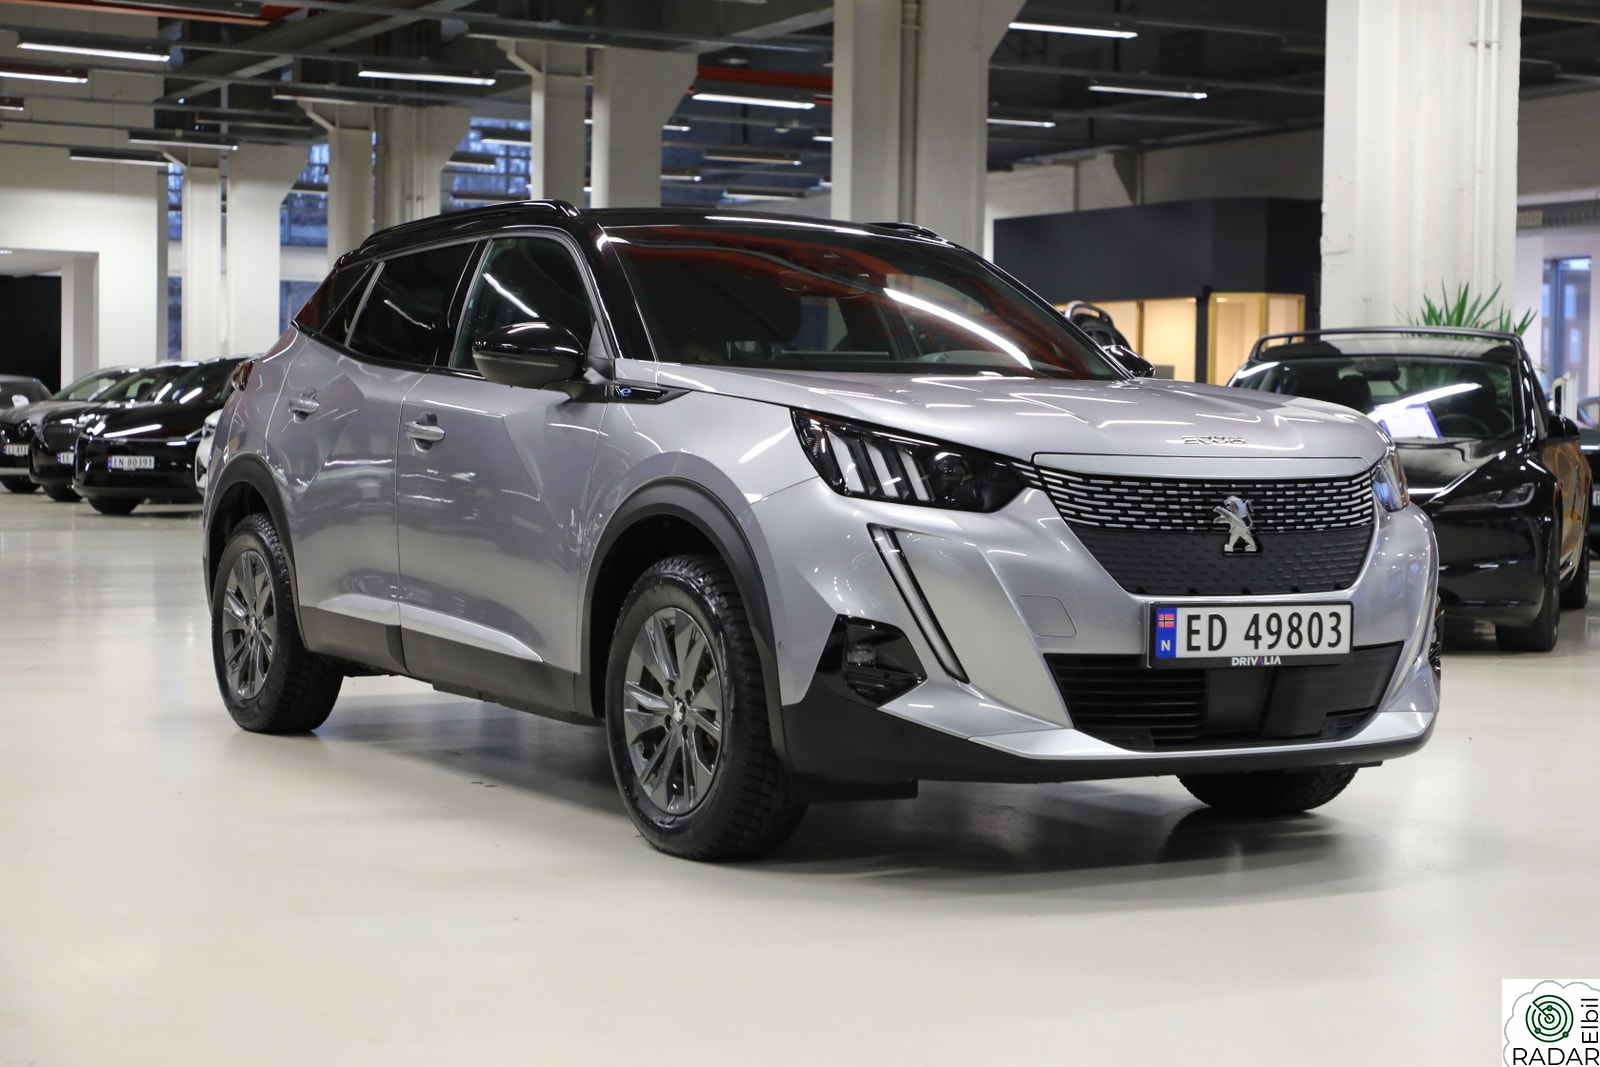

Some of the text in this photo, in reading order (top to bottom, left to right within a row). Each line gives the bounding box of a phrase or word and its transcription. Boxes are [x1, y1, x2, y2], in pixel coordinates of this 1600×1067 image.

[1186, 611, 1342, 652] ED 49803
[1160, 639, 1171, 652] N
[1231, 655, 1282, 667] DRIVALIA
